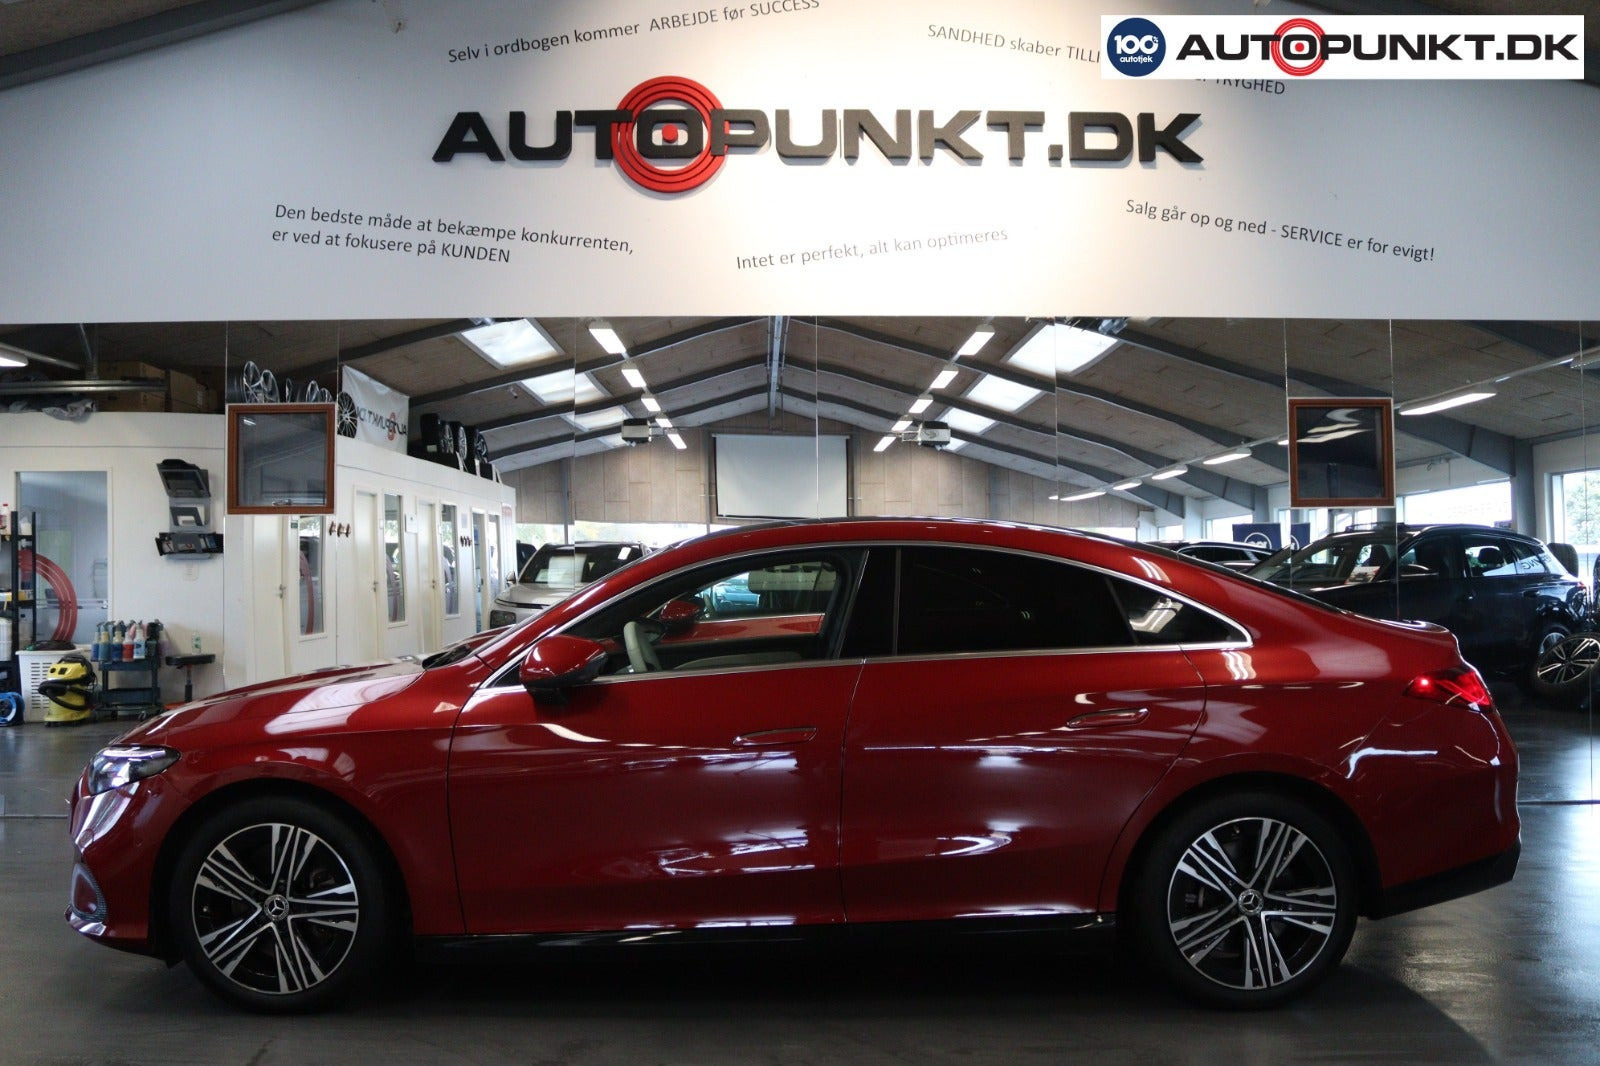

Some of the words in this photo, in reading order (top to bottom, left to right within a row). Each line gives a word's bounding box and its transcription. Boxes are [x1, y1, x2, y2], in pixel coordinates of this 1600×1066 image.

[448, 46, 479, 63] Selv
[484, 44, 489, 57] i
[493, 34, 570, 56] ordbogen
[574, 23, 640, 43] kommer
[650, 9, 719, 32] ARBEJDE
[723, 6, 746, 22] før
[750, 0, 820, 17] SUCCESS
[927, 24, 1006, 48] SANDHED
[1010, 37, 1061, 57] skaber
[1066, 45, 1100, 64] TILLI
[432, 109, 1204, 164] AUTOPUNKT.DK
[272, 230, 288, 242] er
[293, 231, 321, 245] ved
[325, 234, 340, 247] at
[345, 233, 412, 253] fokusere
[417, 240, 436, 256] på
[441, 243, 510, 263] KUNDEN
[275, 204, 306, 220] Den
[311, 207, 363, 225] bedste
[368, 213, 412, 230] måde
[417, 219, 432, 232] at
[437, 219, 516, 242] bekæmpe
[521, 227, 633, 255] konkurrenten,
[736, 253, 775, 270] Intet
[779, 252, 795, 265] er
[801, 243, 864, 265] perfekt,
[869, 240, 889, 255] alt
[894, 238, 922, 252] kan
[927, 228, 1008, 250] optimeres
[1126, 199, 1157, 220] Salg
[1161, 205, 1186, 222] går
[1190, 212, 1210, 227] op
[1214, 215, 1233, 232] og
[1237, 218, 1266, 235] ned
[1280, 225, 1343, 247] SERVICE
[1347, 237, 1363, 250] er
[1367, 237, 1389, 255] for
[1392, 245, 1435, 264] evigt!
